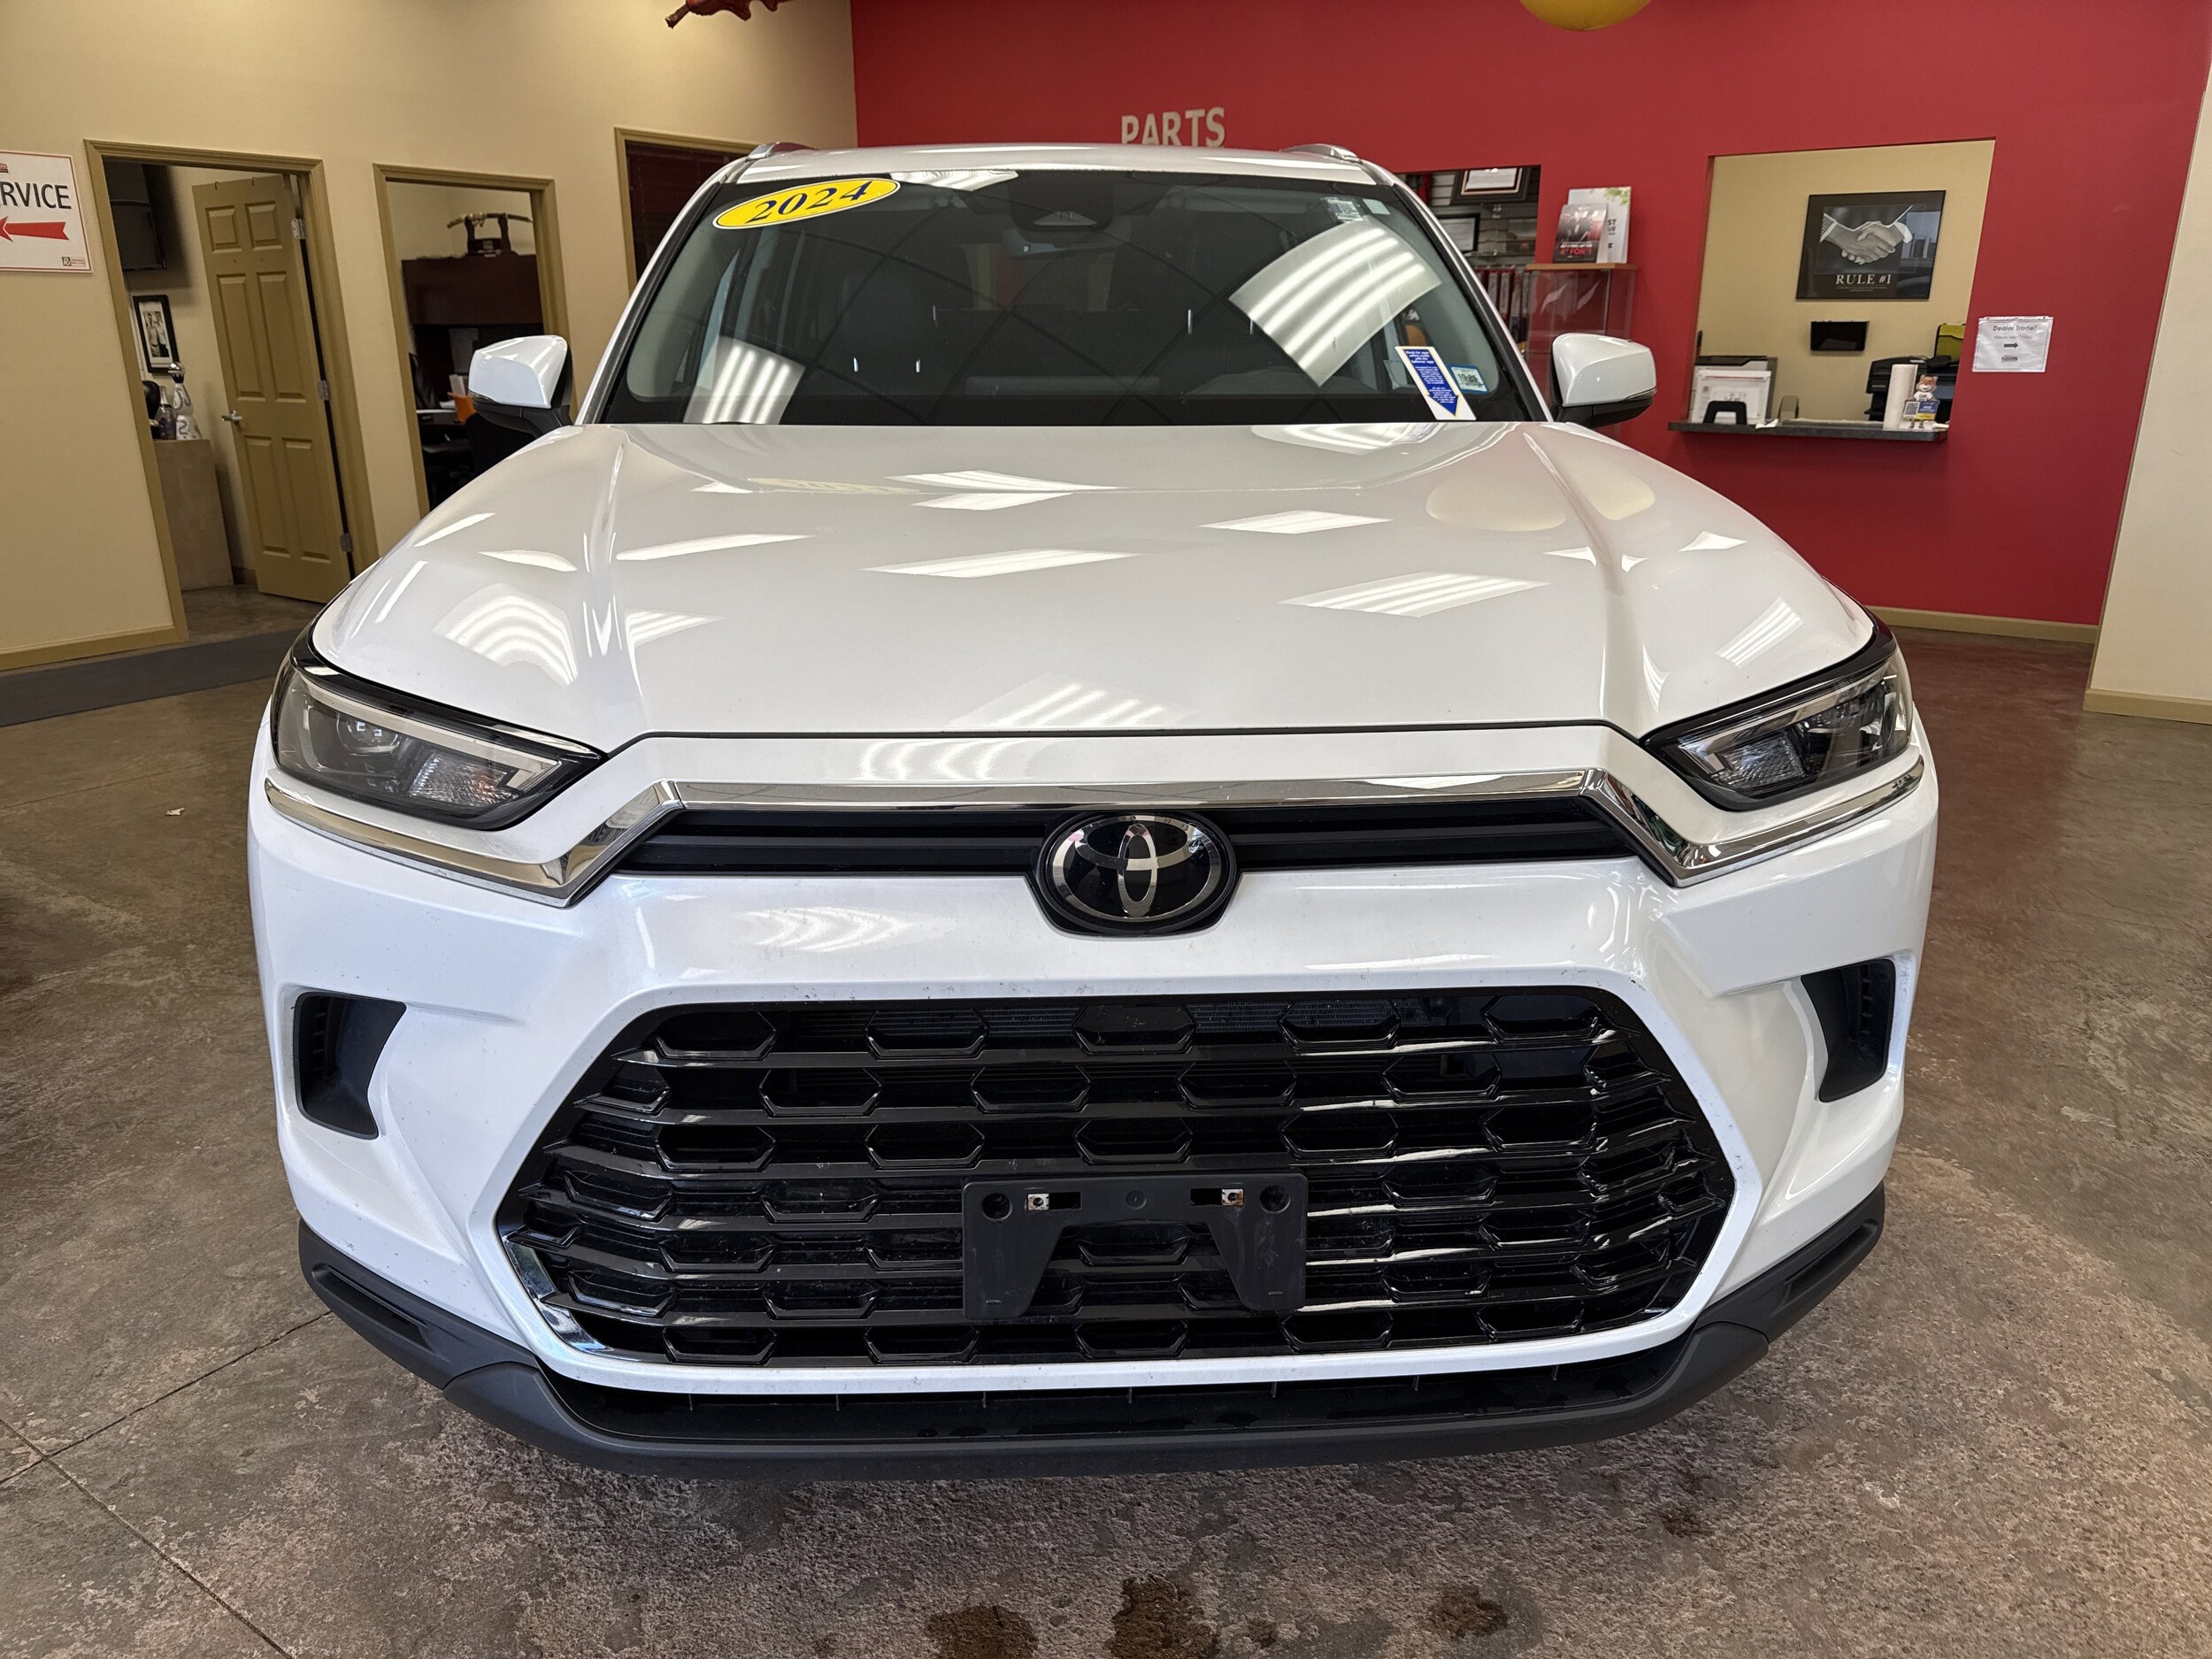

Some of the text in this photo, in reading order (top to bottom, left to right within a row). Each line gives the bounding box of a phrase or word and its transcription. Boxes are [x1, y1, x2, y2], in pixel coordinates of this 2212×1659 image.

[1121, 106, 1225, 148] PARTS
[0, 180, 72, 209] RVICE
[744, 180, 872, 224] 2024
[1835, 273, 1892, 285] RULE #1
